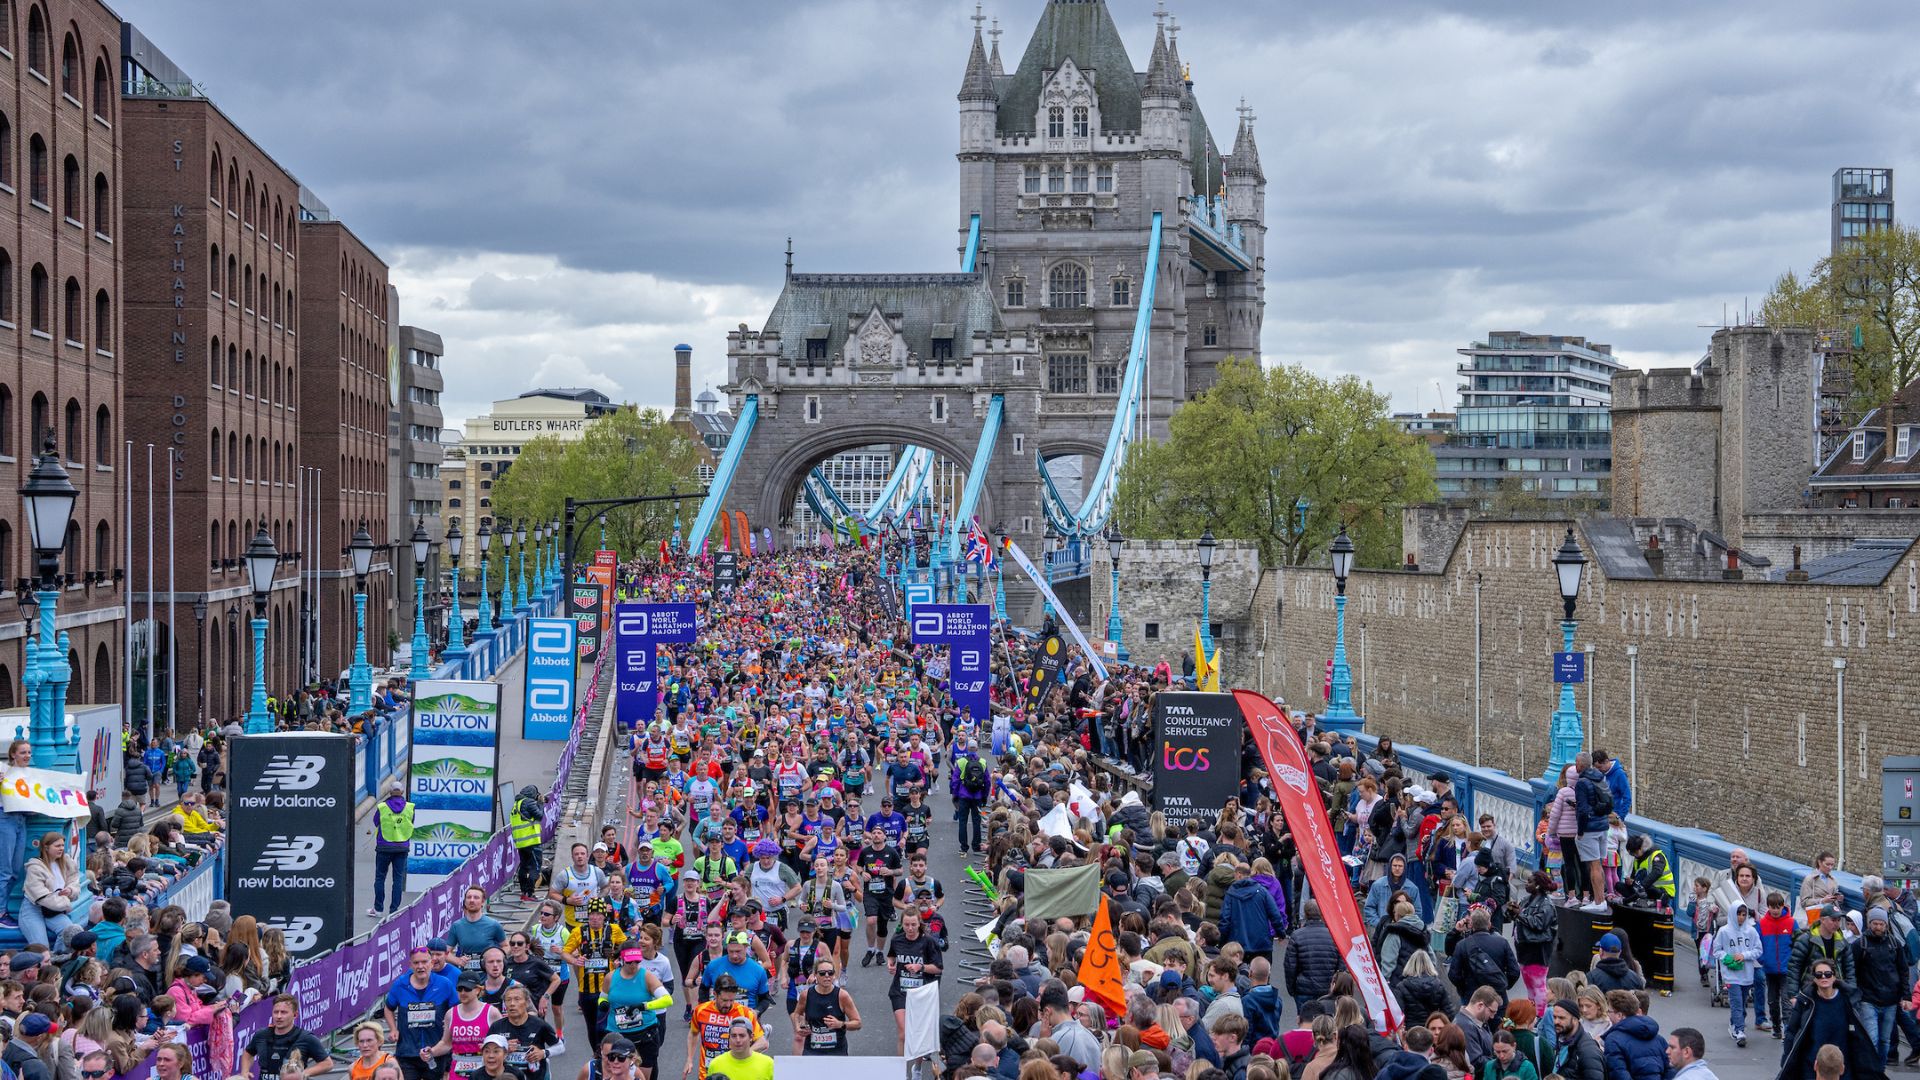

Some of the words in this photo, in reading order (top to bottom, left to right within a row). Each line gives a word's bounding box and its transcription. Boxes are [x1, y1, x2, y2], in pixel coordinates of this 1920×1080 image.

[173, 140, 183, 171] ST
[173, 205, 185, 362] KATHARINE
[172, 395, 186, 480] DOCKS
[533, 656, 571, 666] Abbott
[1041, 655, 1059, 667] Shine
[621, 682, 636, 691] tcs
[954, 681, 969, 691] tcs
[1166, 706, 1195, 715] TATA
[420, 714, 489, 730] BUXTON
[530, 713, 568, 723] Abbott
[1165, 717, 1232, 727] CONSULTANCY
[1164, 727, 1208, 737] SERVICES
[1164, 741, 1210, 772] tcs
[417, 778, 486, 794] BUXTON
[239, 796, 271, 808] new
[274, 794, 336, 808] balance
[1163, 797, 1192, 806] TATA
[238, 876, 269, 889] new
[273, 875, 335, 889] balance
[897, 954, 924, 965] MAYA
[301, 973, 321, 992] ABBOTT
[302, 988, 321, 1005] WORLD
[302, 998, 330, 1020] MARATHON
[709, 1013, 733, 1025] BEN
[452, 1026, 480, 1037] ROSS
[705, 1036, 729, 1044] CANCER
